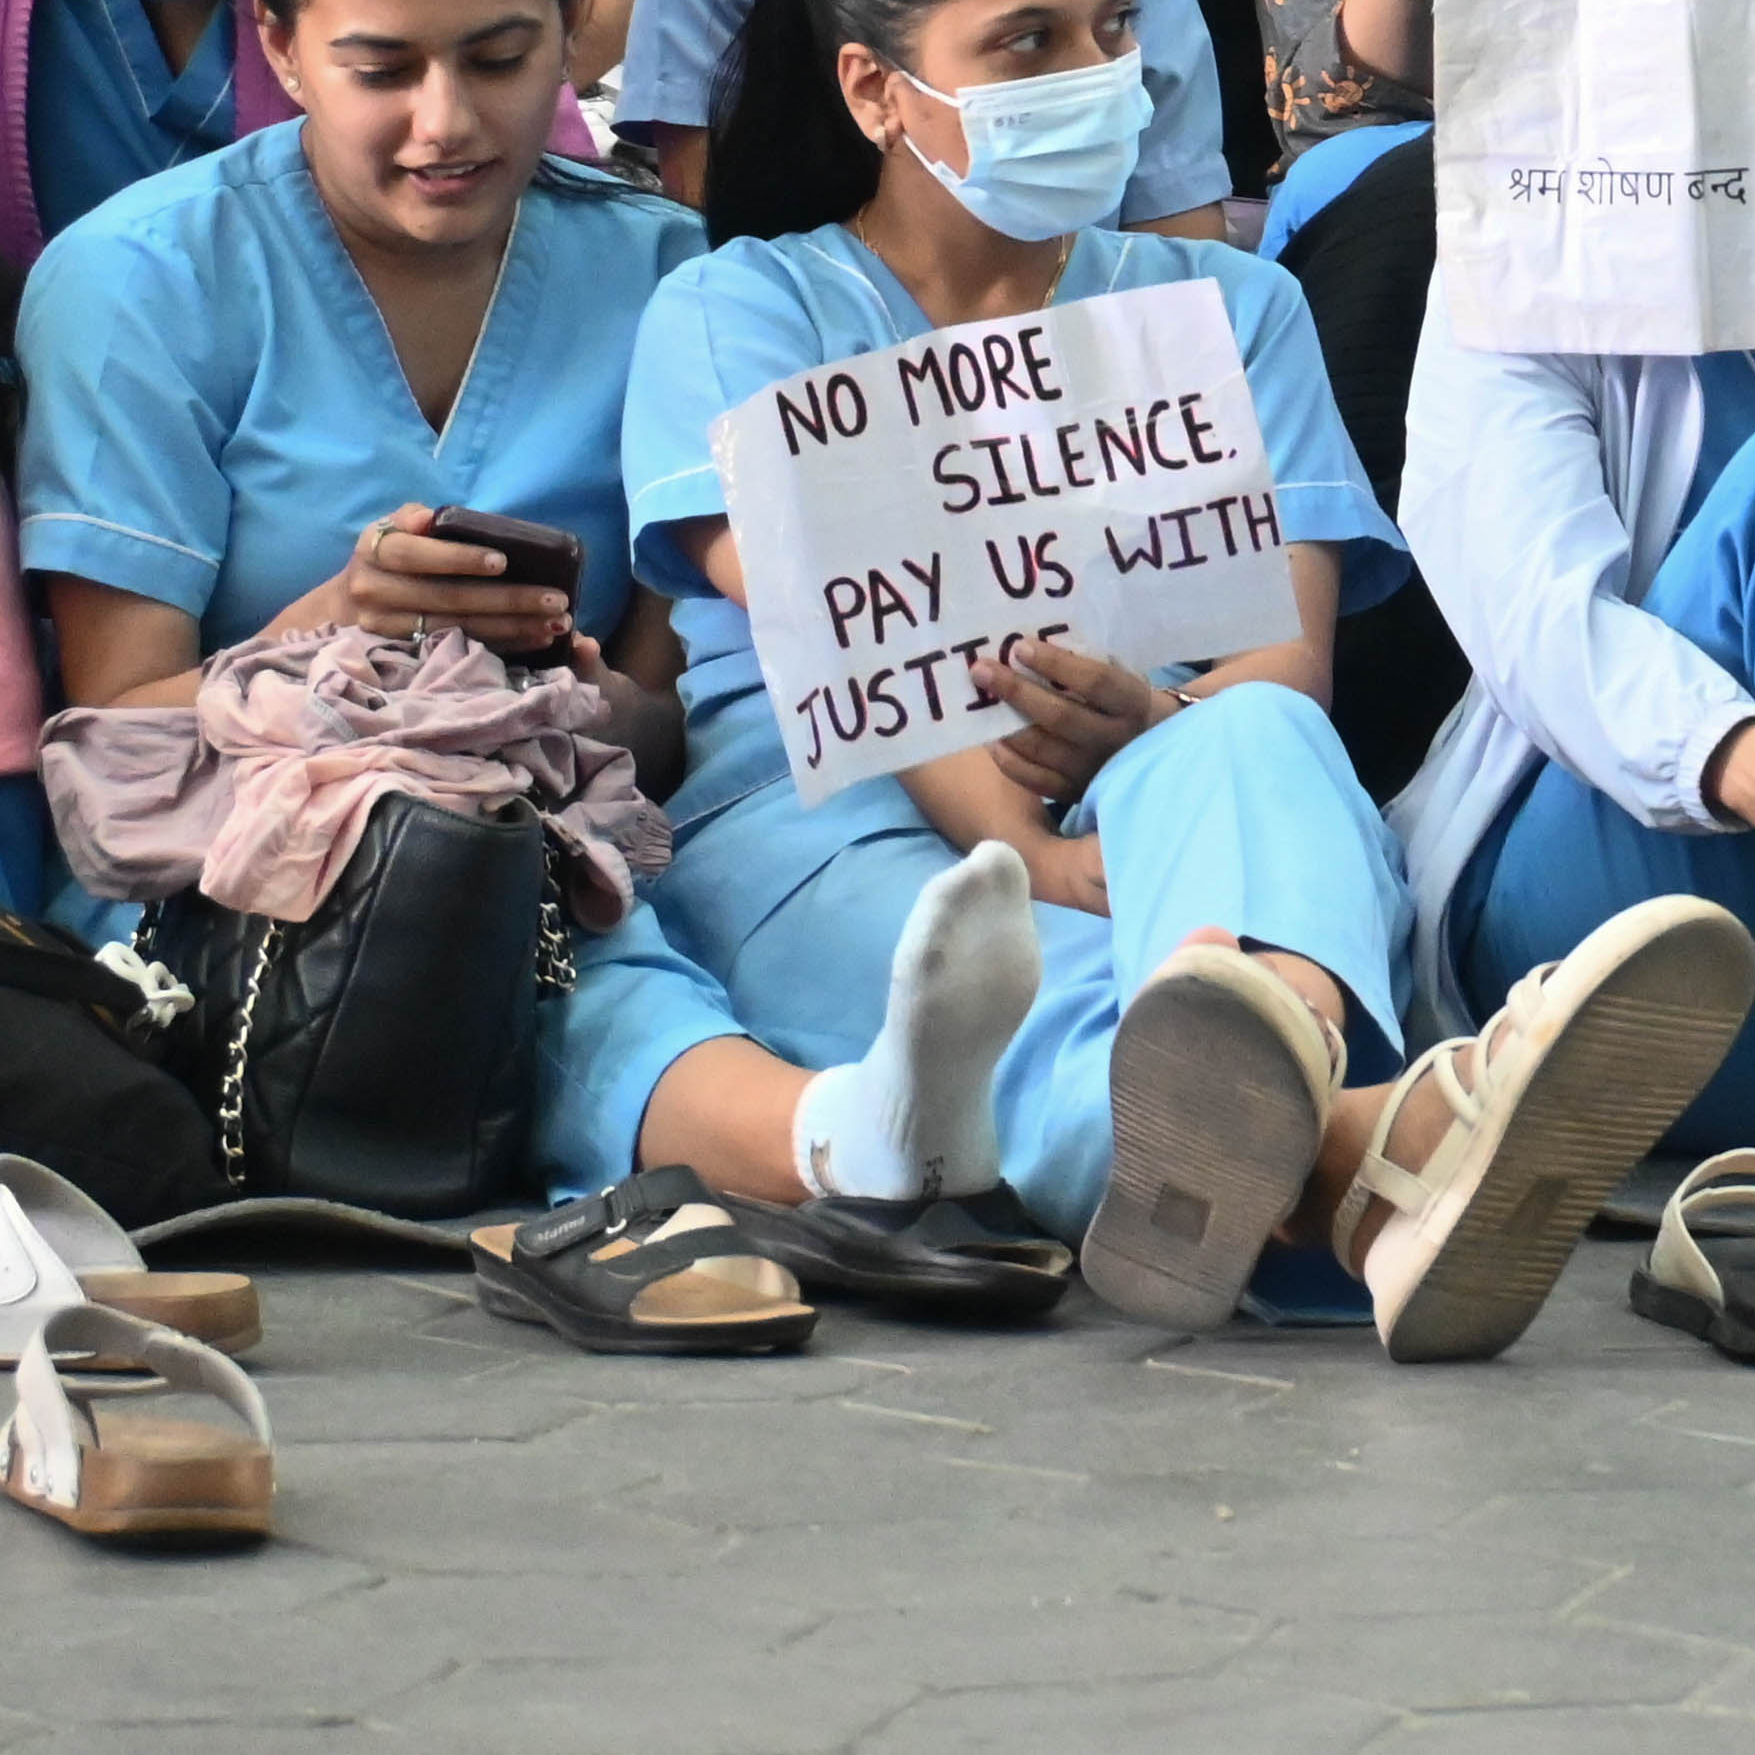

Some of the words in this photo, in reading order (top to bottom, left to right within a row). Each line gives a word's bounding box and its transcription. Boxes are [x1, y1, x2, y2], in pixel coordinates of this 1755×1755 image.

[1509, 167, 1567, 204] श्रम
[1578, 157, 1675, 206] शोषण
[1684, 166, 1750, 205] बन्द
[774, 371, 869, 457] NO
[897, 325, 1064, 427] MORE
[822, 551, 943, 649] PAY
[985, 531, 1074, 601] US
[1104, 492, 1282, 575] WITH
